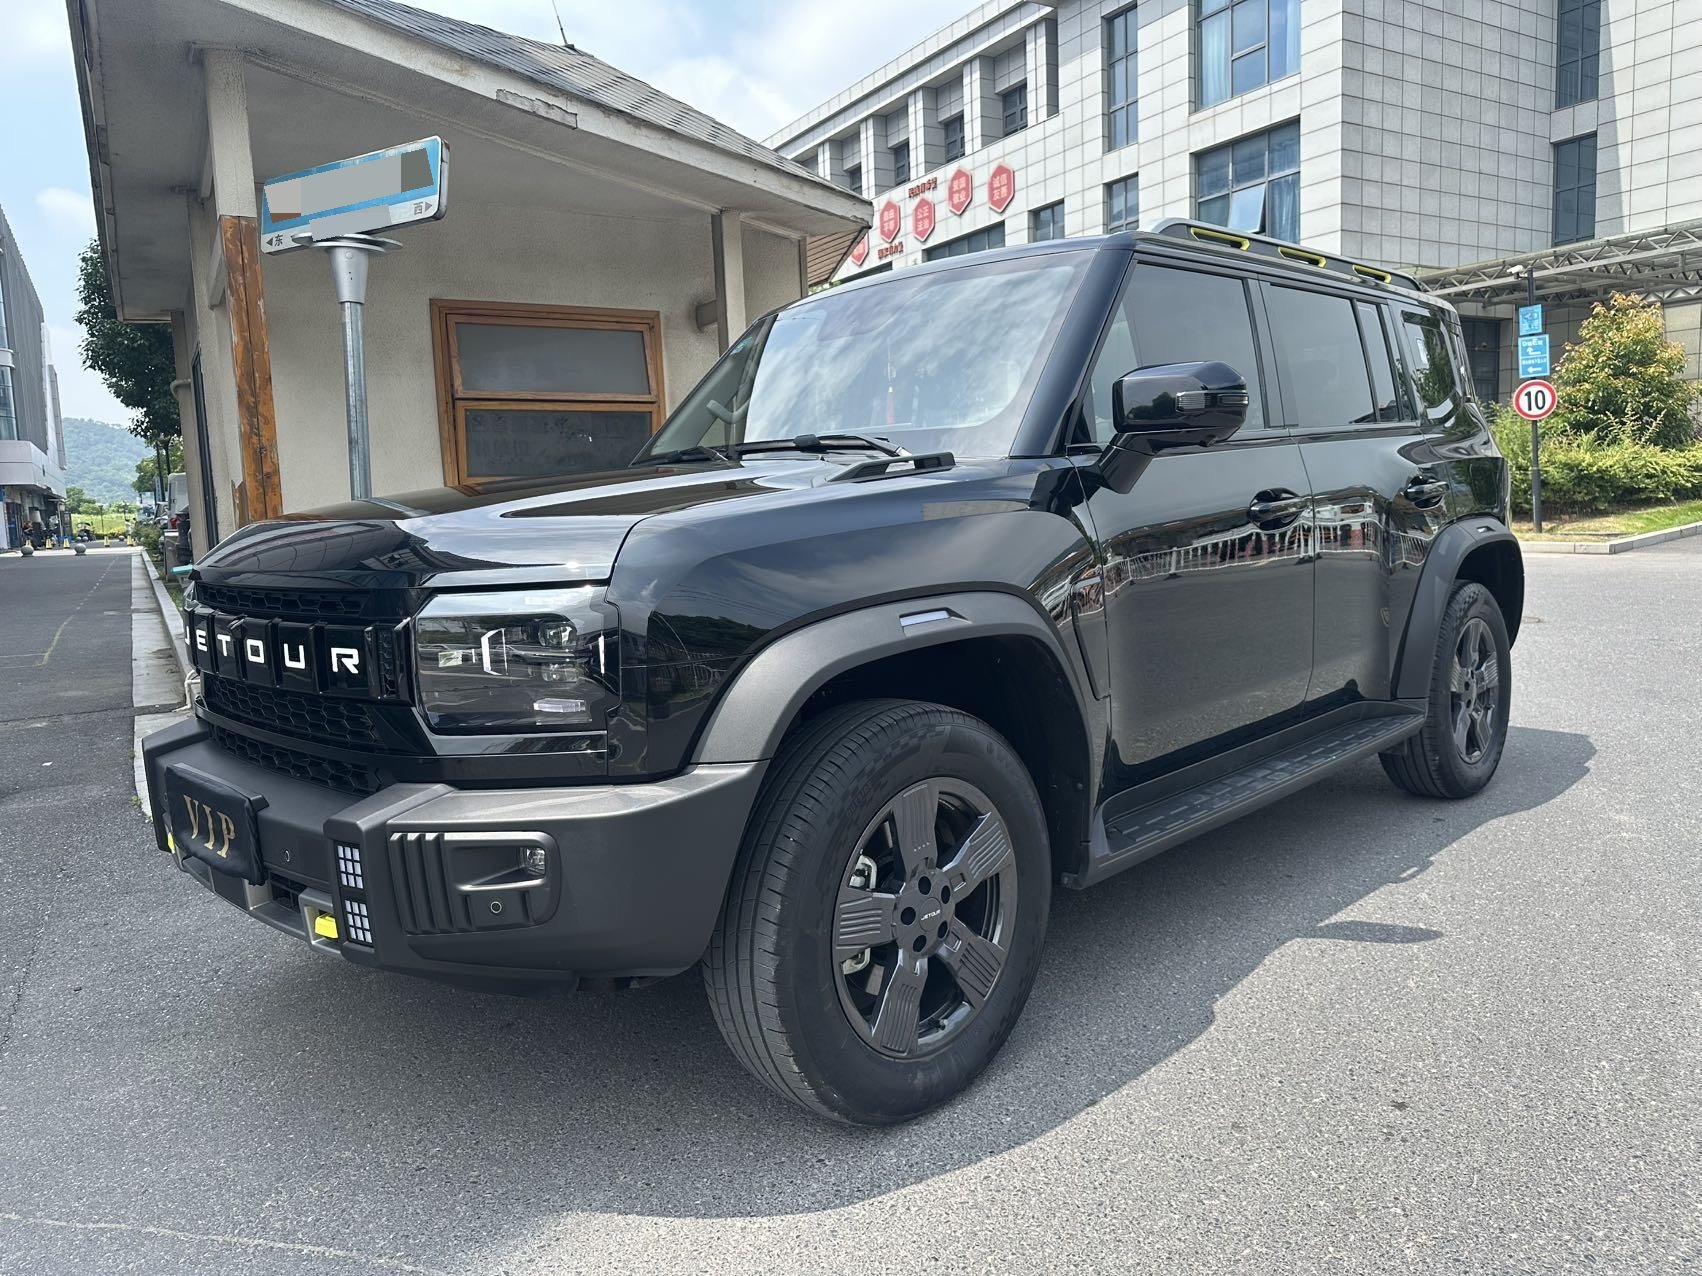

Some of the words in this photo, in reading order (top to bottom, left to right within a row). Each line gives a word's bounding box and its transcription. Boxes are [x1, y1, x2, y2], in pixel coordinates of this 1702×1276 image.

[414, 202, 424, 215] 西
[1525, 390, 1546, 411] 10
[184, 626, 360, 674] JETOUR
[183, 795, 236, 858] VIP
